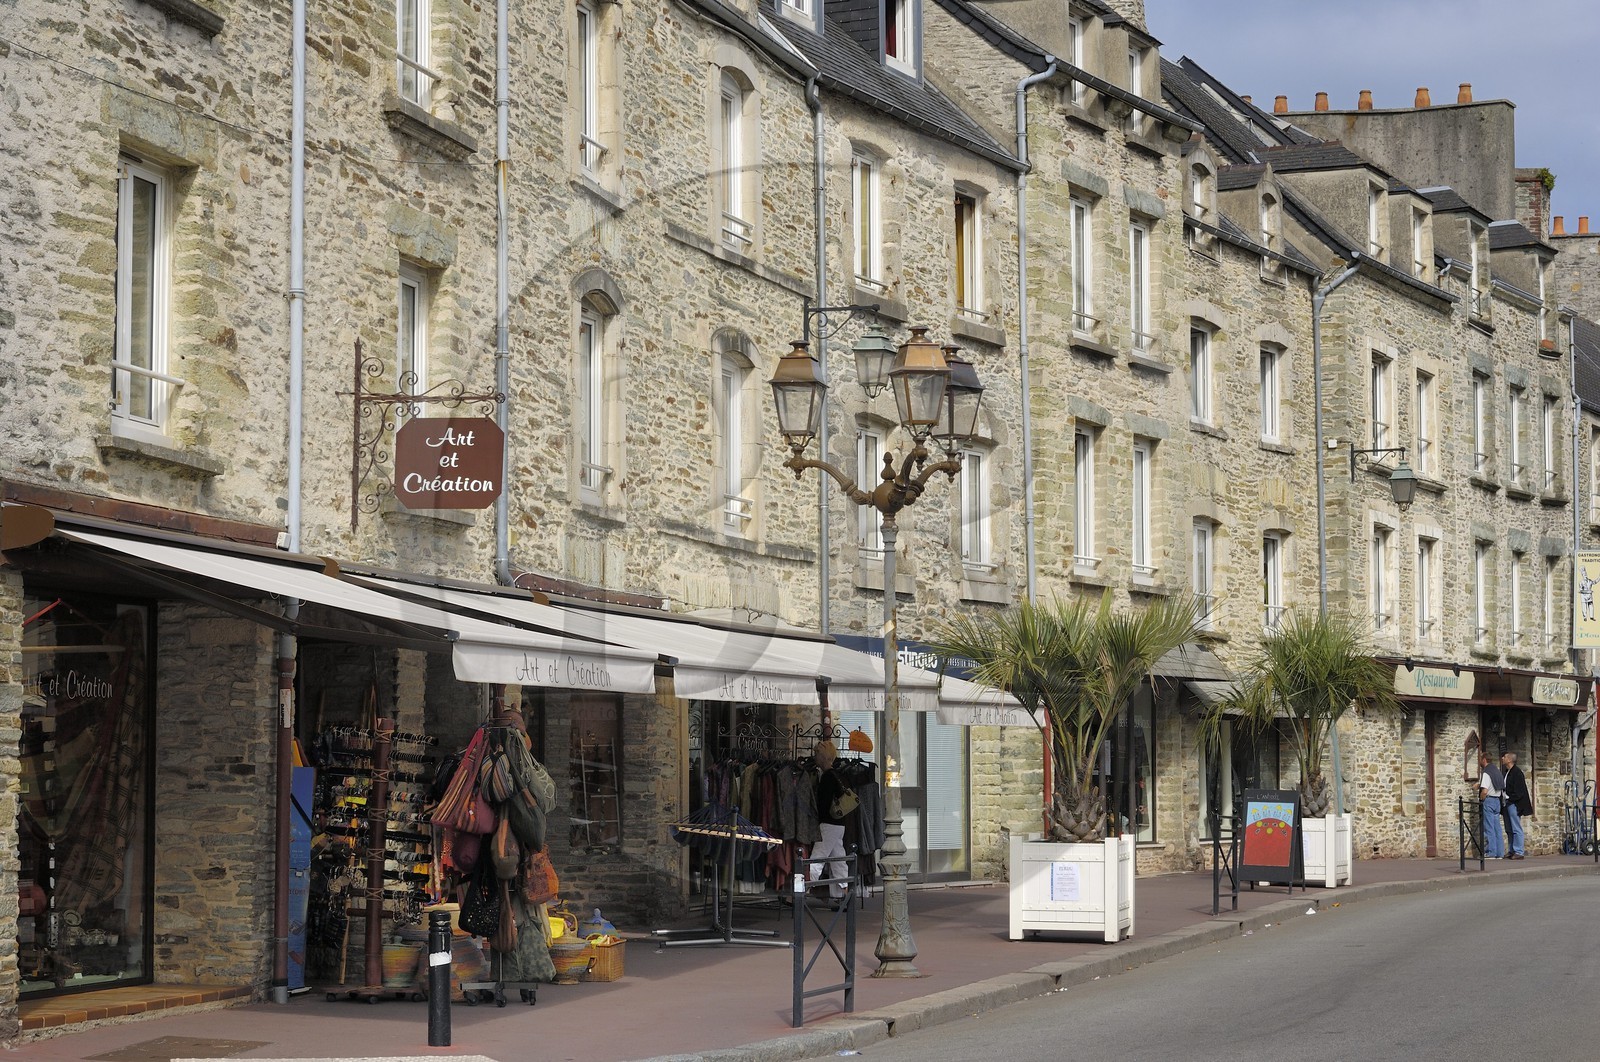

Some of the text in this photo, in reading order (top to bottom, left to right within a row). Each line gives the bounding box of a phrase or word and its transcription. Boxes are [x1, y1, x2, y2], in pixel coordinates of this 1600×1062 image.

[425, 427, 475, 448] Art
[439, 452, 459, 468] et
[403, 472, 494, 494] Création
[515, 652, 612, 687] Art et Création
[49, 674, 60, 696] et
[66, 670, 114, 700] Création
[718, 674, 784, 702] Art et Création
[1414, 668, 1459, 694] Restaurant
[864, 689, 877, 709] Art
[969, 705, 1018, 725] Art et Création
